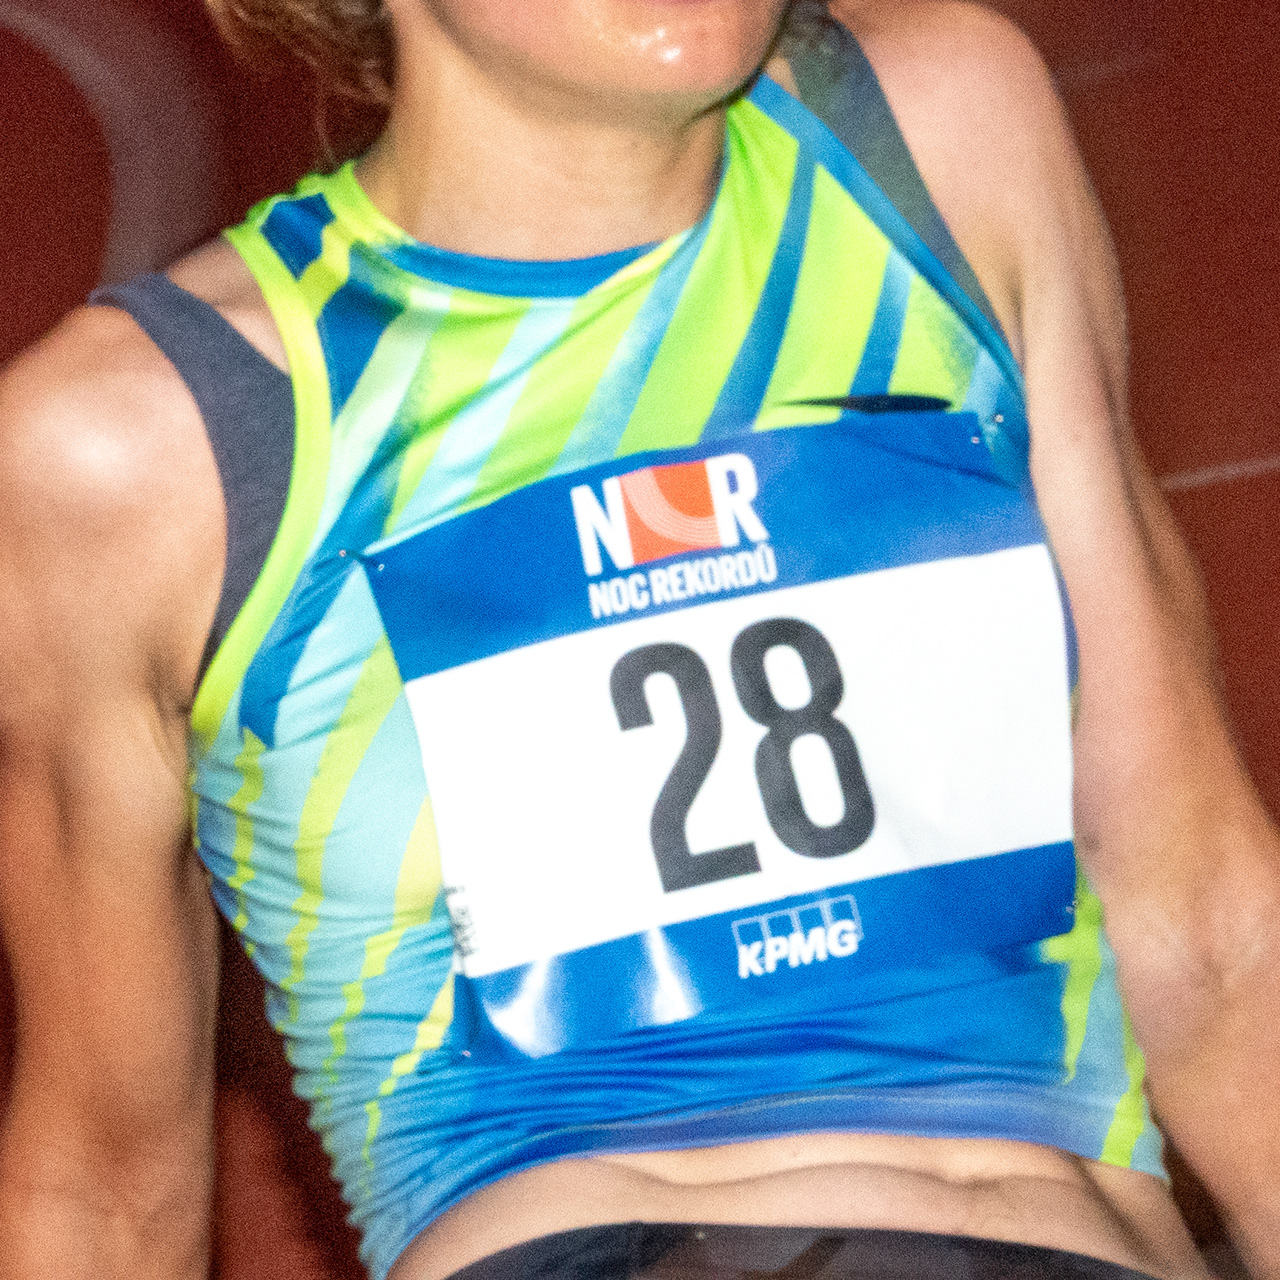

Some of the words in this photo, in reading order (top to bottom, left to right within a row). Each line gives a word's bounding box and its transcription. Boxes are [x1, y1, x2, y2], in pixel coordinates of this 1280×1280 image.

[587, 572, 651, 619] NOC
[608, 616, 877, 894] 28
[738, 919, 859, 979] KPMG
